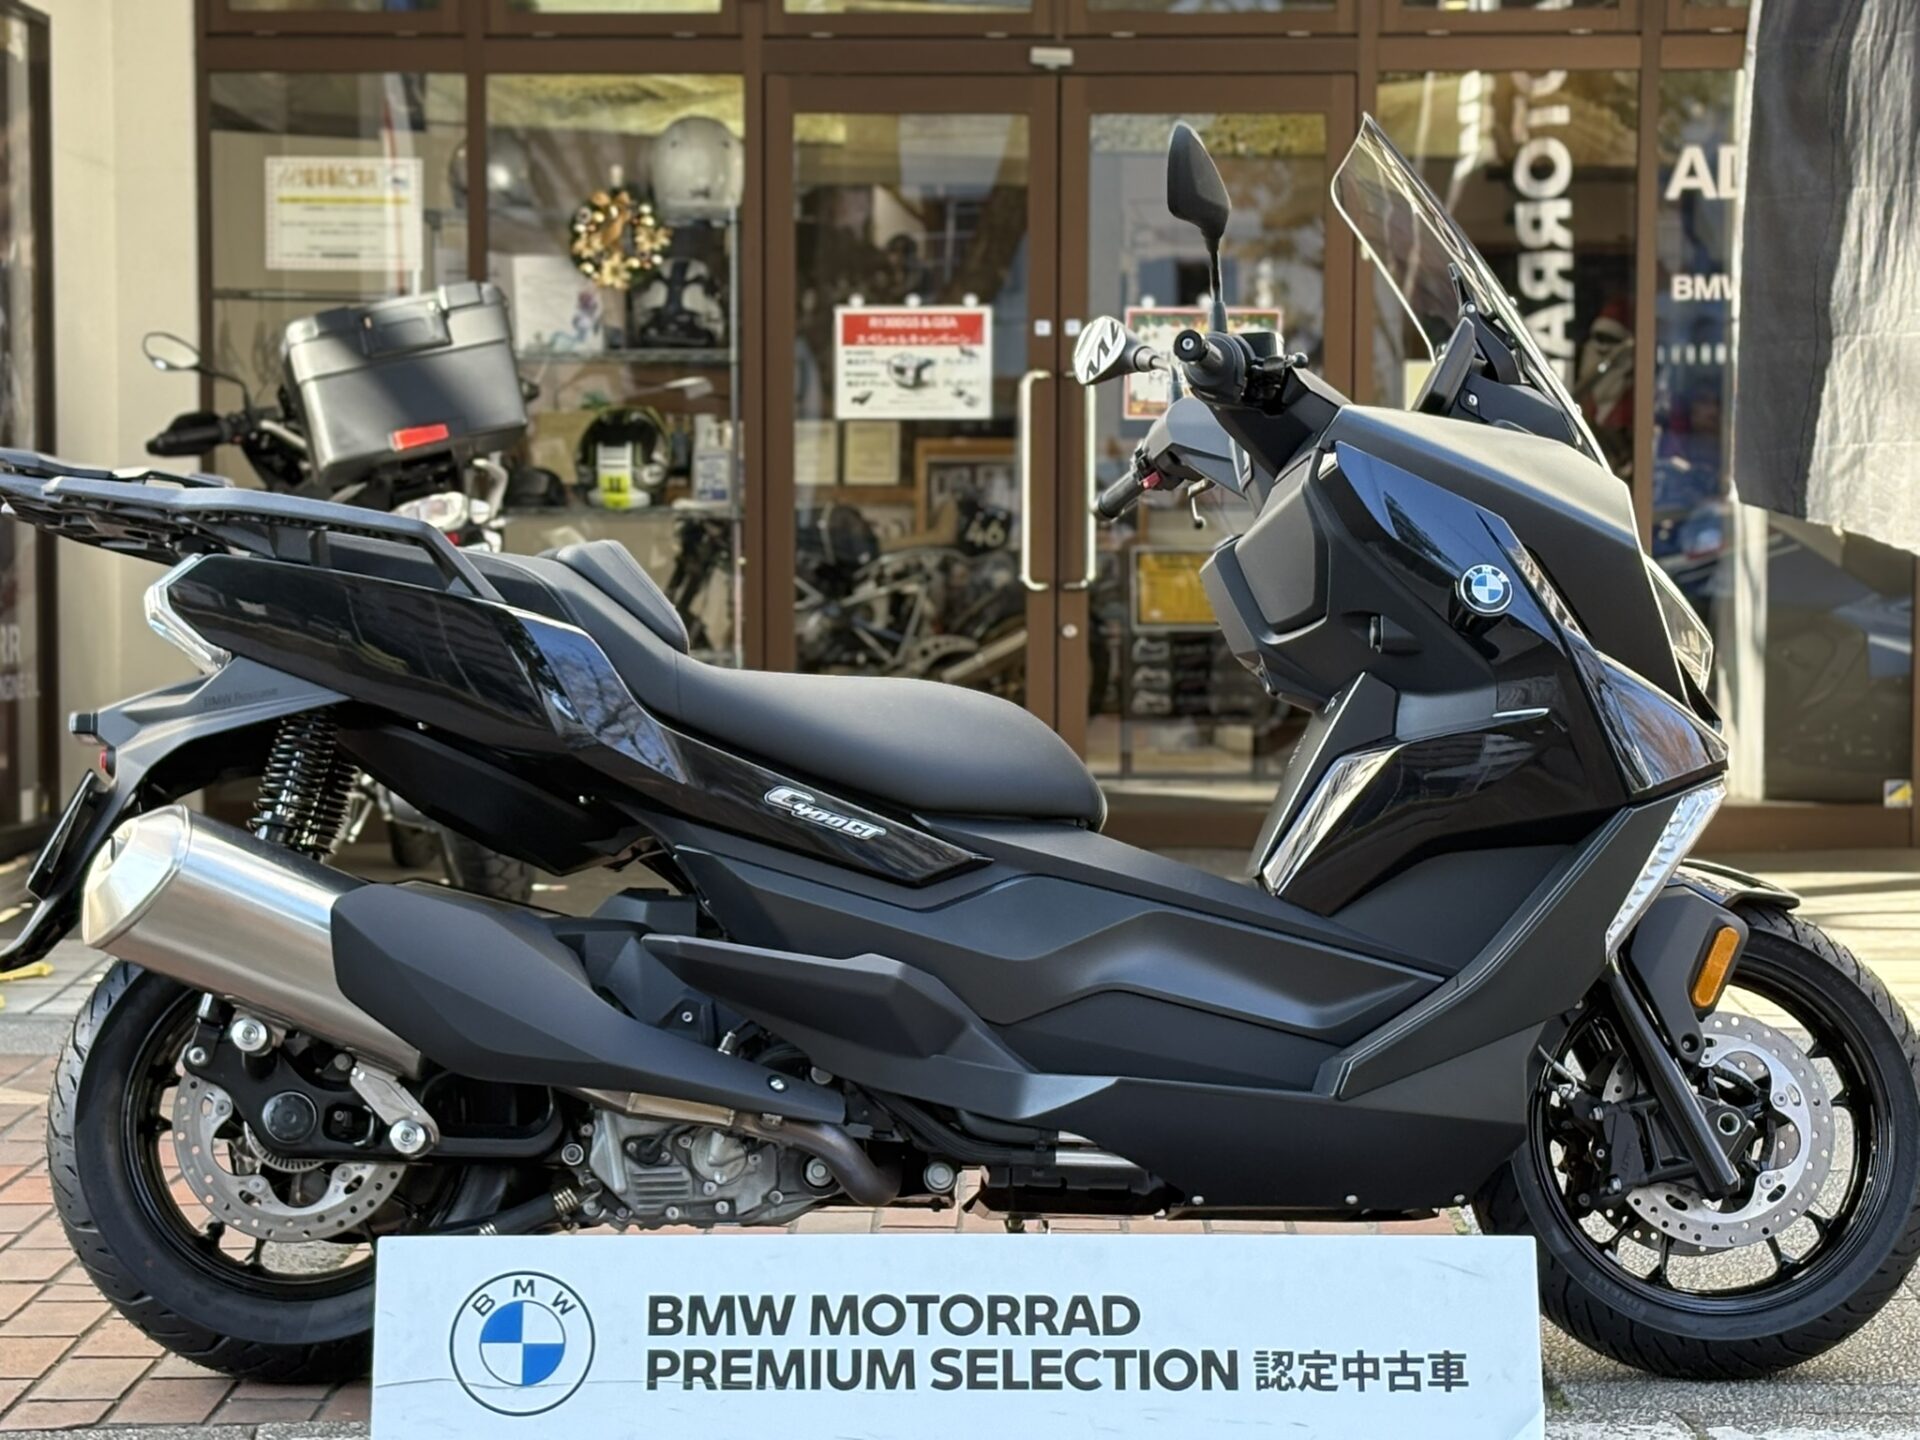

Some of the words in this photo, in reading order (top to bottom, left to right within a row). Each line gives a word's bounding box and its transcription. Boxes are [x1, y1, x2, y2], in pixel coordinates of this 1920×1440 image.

[471, 1278, 578, 1318] BMW
[648, 1295, 795, 1335] BMW
[810, 1294, 1140, 1336] MOTORRAD
[647, 1349, 915, 1390] PREMIUM
[930, 1348, 1238, 1391] SELECTION
[1254, 1349, 1468, 1392] 認定中古車
